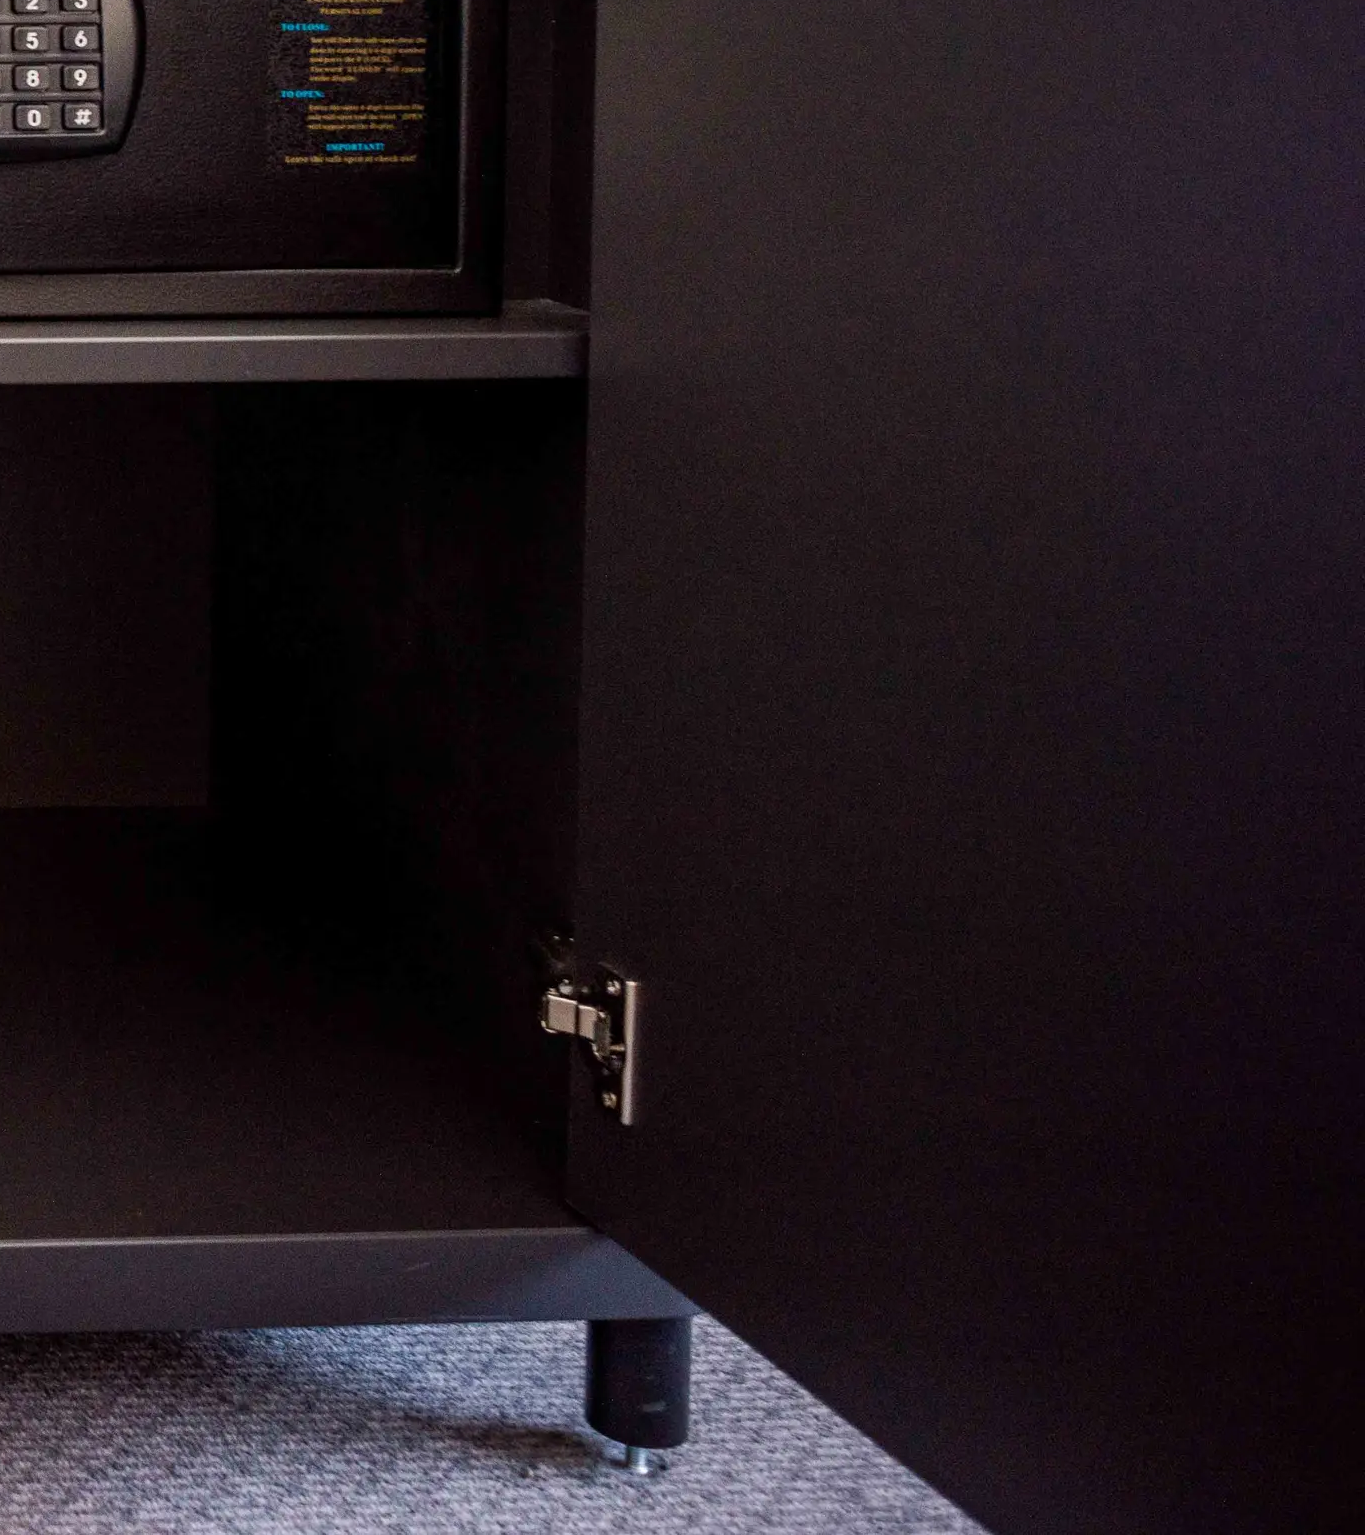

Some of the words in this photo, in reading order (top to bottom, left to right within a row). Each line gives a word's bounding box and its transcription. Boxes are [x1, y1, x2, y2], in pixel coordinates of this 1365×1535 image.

[26, 32, 39, 49] 5
[75, 30, 88, 47] 6
[26, 70, 40, 87] 8
[74, 69, 87, 87] 9
[27, 110, 41, 126] 0
